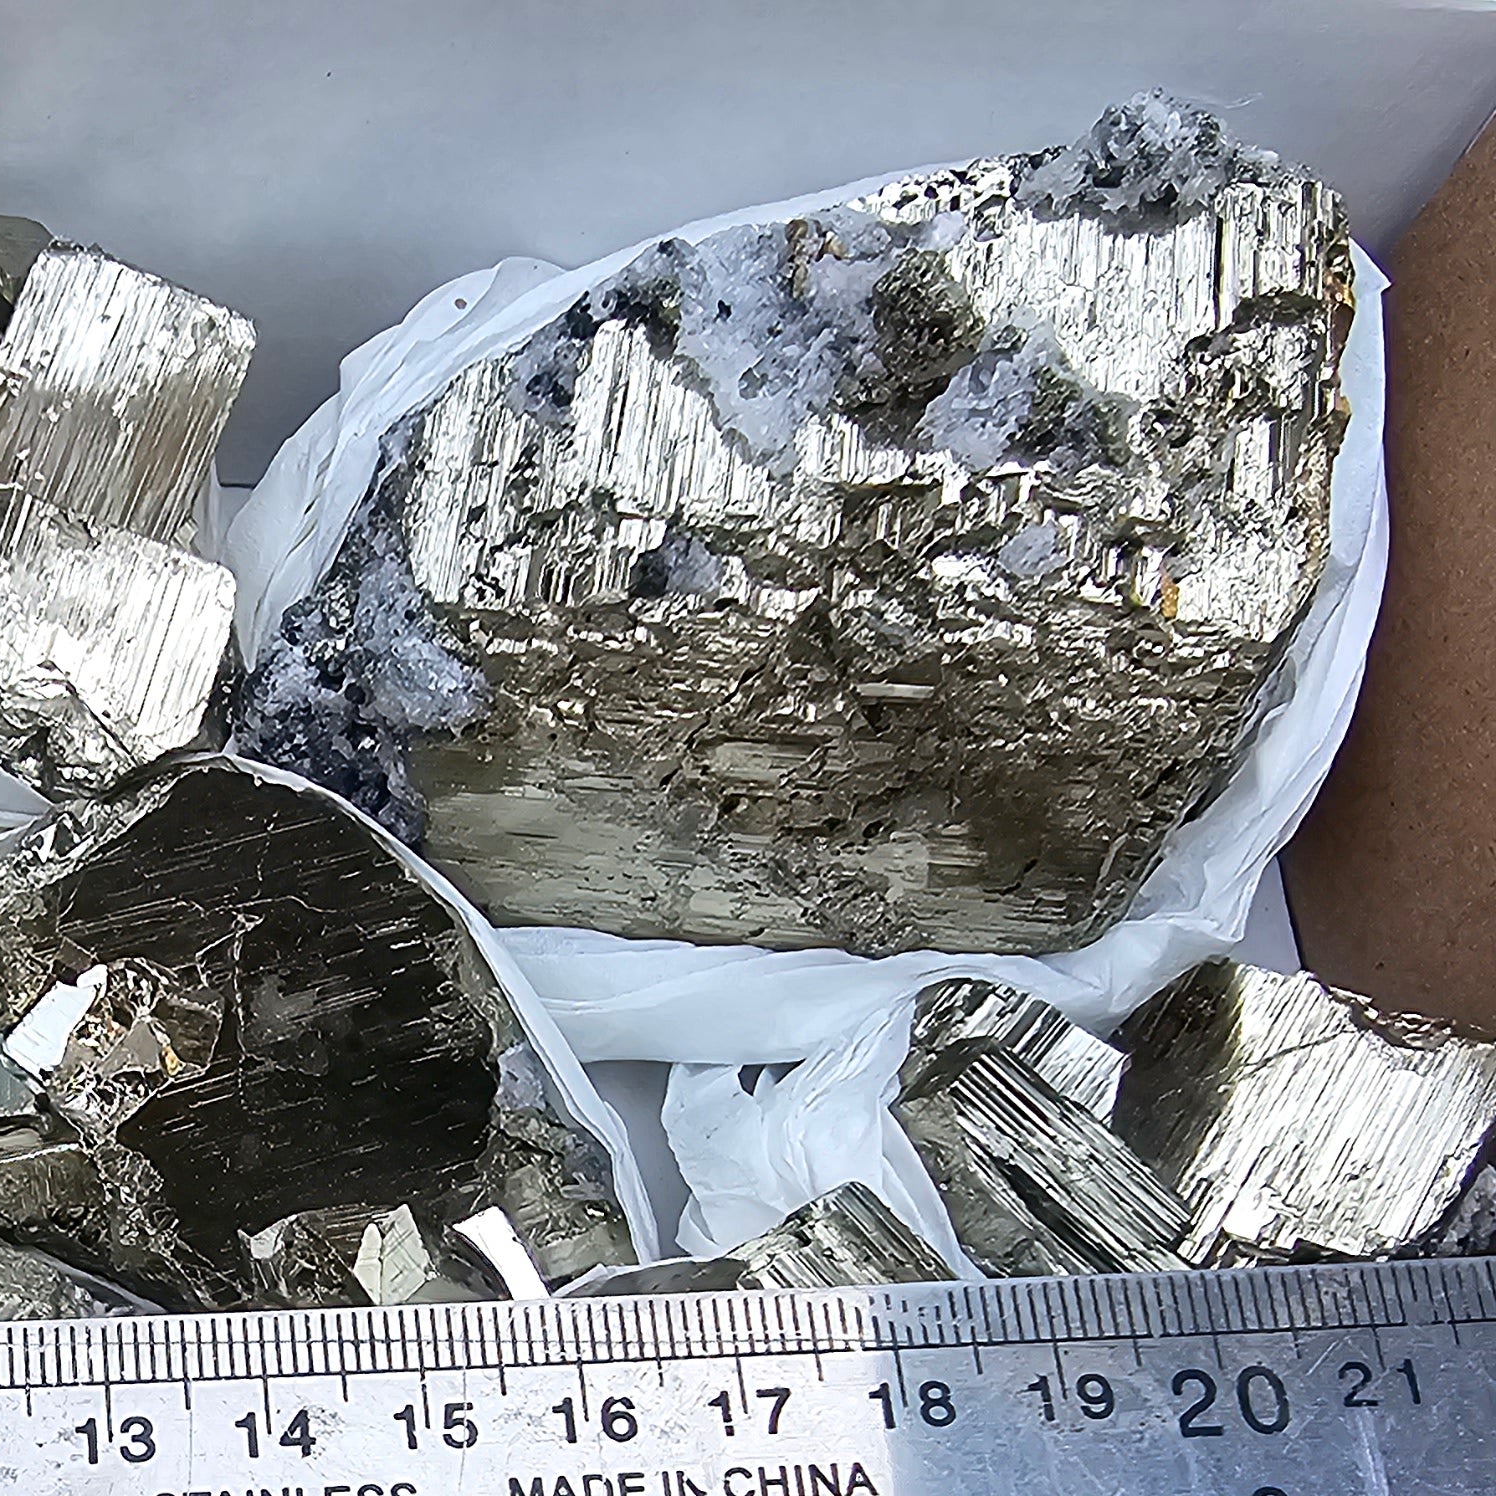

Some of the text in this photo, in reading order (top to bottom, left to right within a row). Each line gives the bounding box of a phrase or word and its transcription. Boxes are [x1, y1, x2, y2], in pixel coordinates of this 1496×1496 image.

[75, 1416, 156, 1464] 13
[235, 1409, 316, 1457] 14
[394, 1402, 477, 1450] 15
[553, 1396, 638, 1443] 16
[709, 1387, 791, 1437] 17
[869, 1380, 956, 1429] 18
[1027, 1373, 1115, 1421] 19
[1171, 1365, 1289, 1437] 20
[1337, 1359, 1421, 1407] 21
